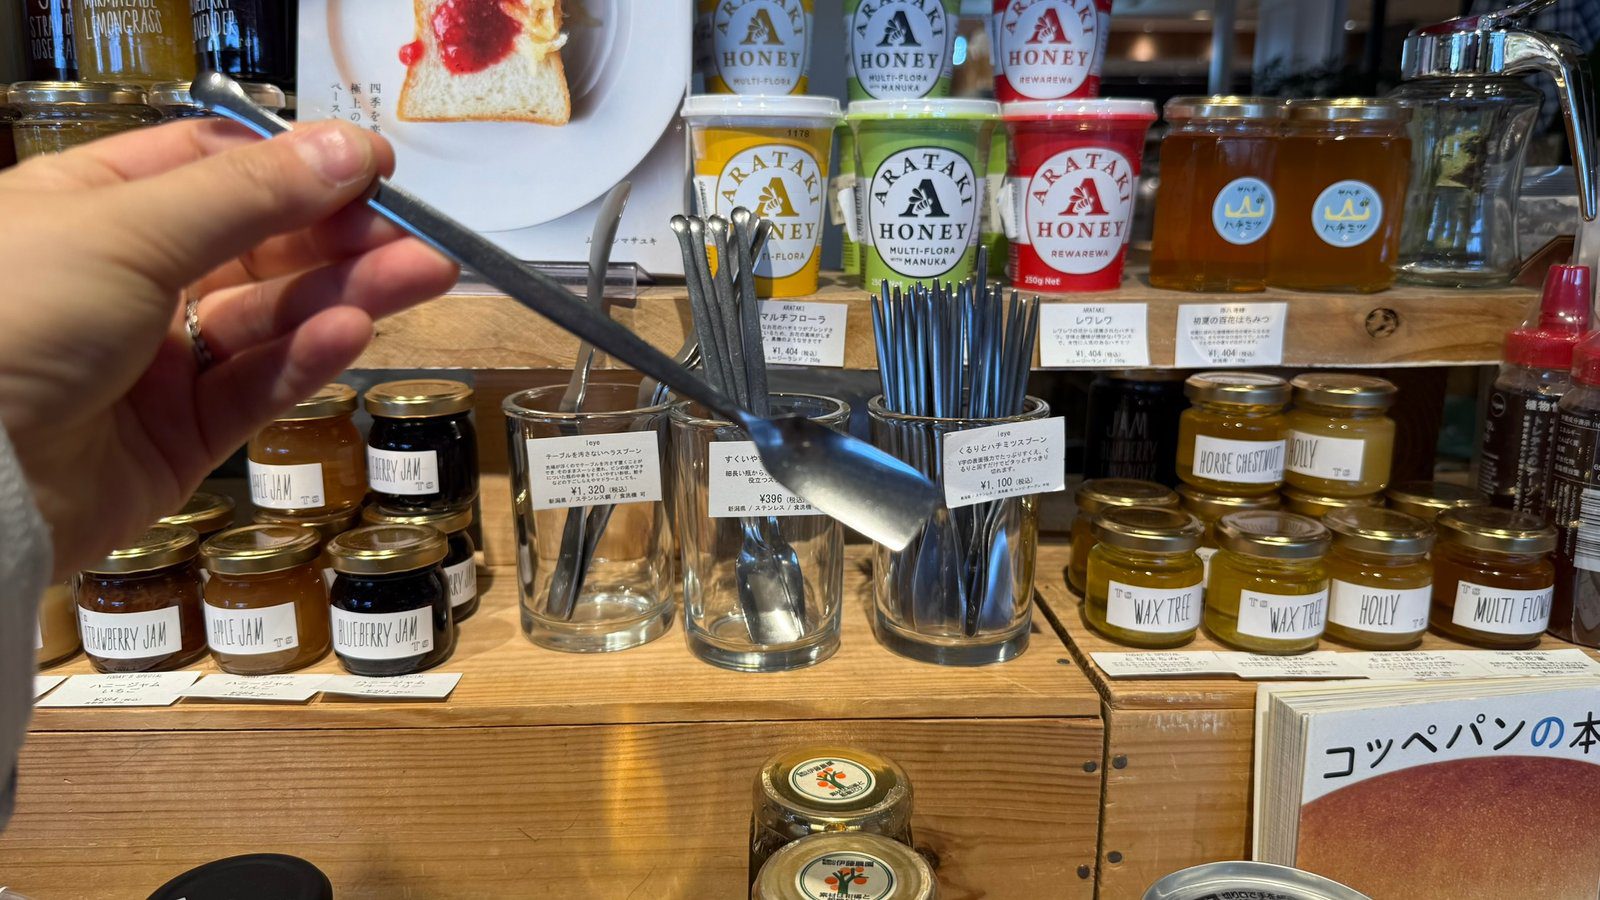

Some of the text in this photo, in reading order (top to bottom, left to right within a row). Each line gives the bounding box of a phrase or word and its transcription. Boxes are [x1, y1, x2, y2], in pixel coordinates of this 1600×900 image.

[723, 51, 800, 67] HONEY
[861, 53, 938, 69] HONEY
[1008, 50, 1088, 66] HONEY
[1019, 76, 1072, 84] REWAREWA
[331, 83, 342, 119] ペース
[350, 83, 361, 127] 極上の
[722, 151, 819, 206] ARATAKI
[875, 153, 972, 207] ARATAKI
[1033, 153, 1129, 206] ARATAKI
[770, 223, 816, 240] NEY
[880, 223, 967, 240] HONEY
[1037, 221, 1125, 238] HONEY
[762, 253, 806, 261] TI-FLORA
[890, 247, 955, 255] MULTI-FLORA
[1051, 249, 1109, 258] REWAREWA
[904, 257, 947, 266] MANUKA
[1045, 277, 1061, 286] Net
[760, 313, 826, 324] マルチフローラ
[1076, 316, 1112, 325] レワレワ
[1106, 409, 1148, 440] JAM
[546, 448, 642, 460] テーブルを汚さないヘラスプーン
[959, 436, 1047, 455] くるりとハチミツスプーン
[1288, 438, 1318, 469] HOLLY
[1199, 445, 1281, 474] HORSE CHESTNUT
[400, 457, 421, 481] JAM
[270, 474, 291, 501] JAM
[571, 485, 628, 496] ¥1,320 (税込)
[980, 477, 1012, 490] ¥1,100
[759, 493, 782, 504] ¥396
[1134, 592, 1193, 625] WAX TREE
[1270, 598, 1324, 633] WAX TREE
[1359, 593, 1401, 626] HOLLY
[1473, 597, 1515, 624] MULTI
[84, 621, 166, 651] STRAWBERRY JAM
[213, 616, 264, 646] APPLE JAM
[338, 615, 418, 647] BLUEBERRY JAM
[89, 681, 160, 689] ハニージャム
[1323, 710, 1600, 779] コッペパンの本
